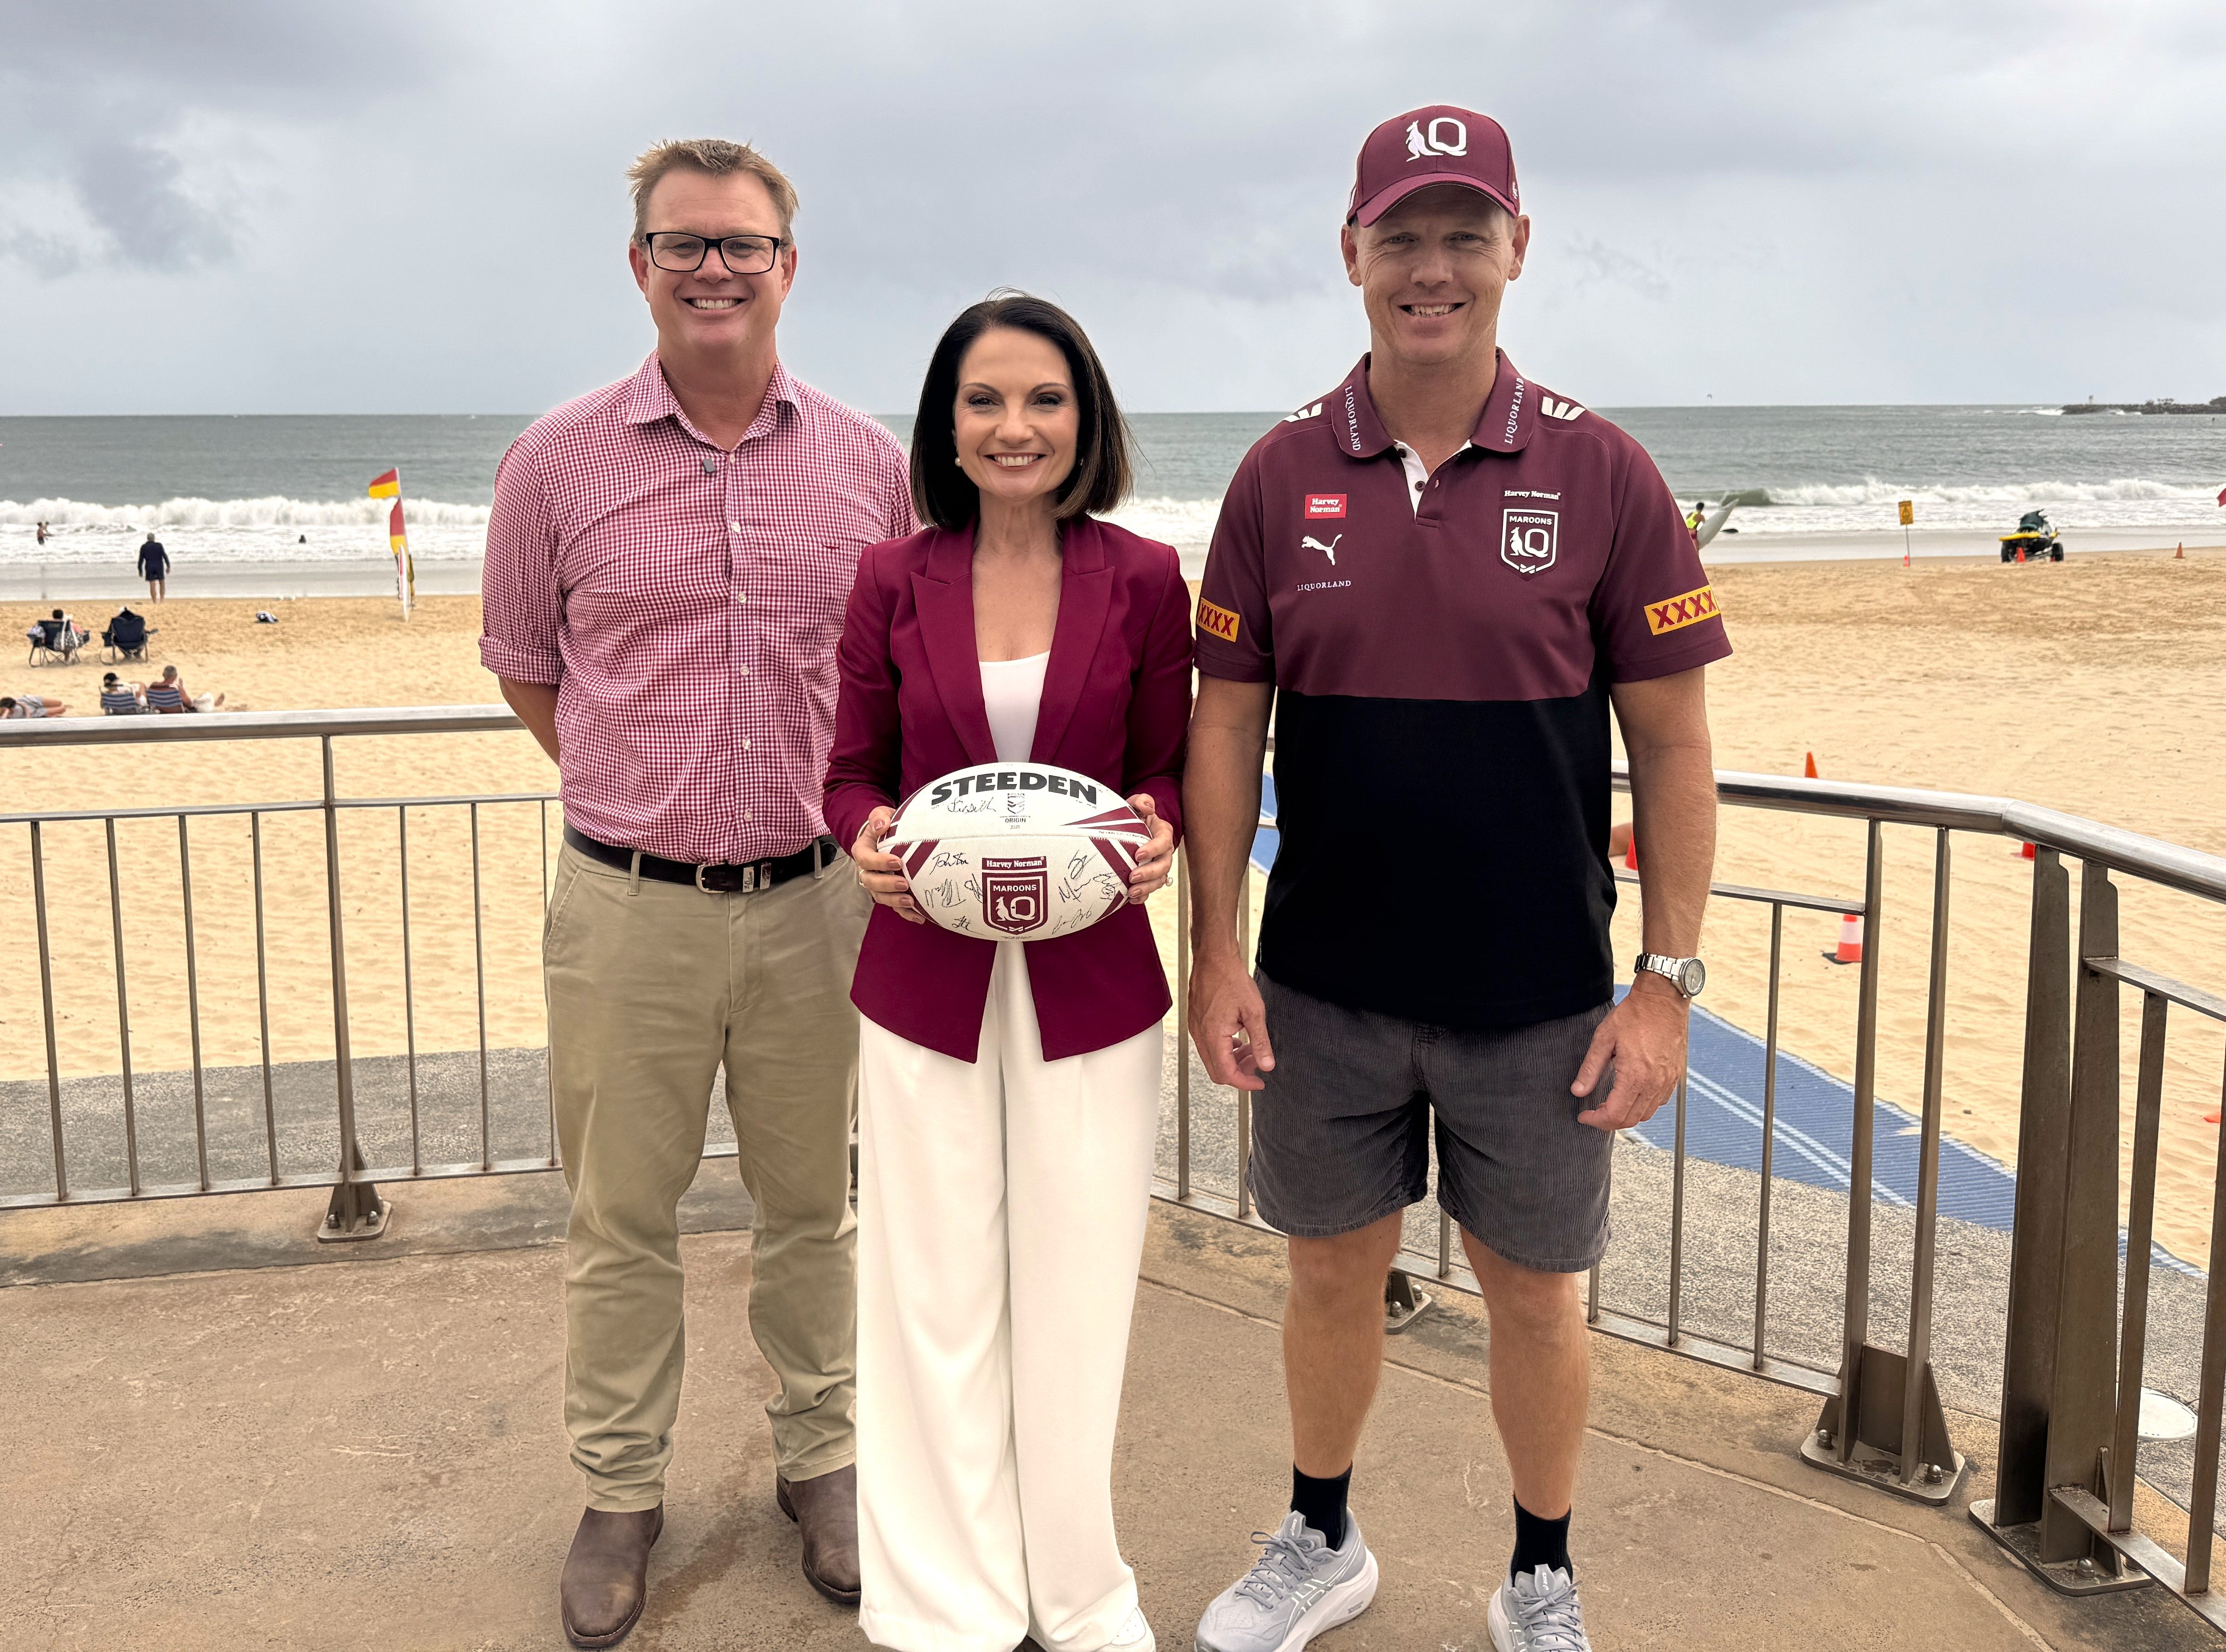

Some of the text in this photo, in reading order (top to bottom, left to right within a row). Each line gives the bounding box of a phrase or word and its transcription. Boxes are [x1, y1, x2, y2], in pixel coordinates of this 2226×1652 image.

[1345, 385, 1361, 451] LIQUORLAND
[1504, 377, 1524, 444] LIQUORLAND
[1531, 490, 1559, 500] Norman
[1509, 516, 1552, 525] MAROONS
[1297, 580, 1351, 591] LIQUORLAND
[1198, 603, 1235, 637] XXXX
[1651, 590, 1717, 629] XXXX
[932, 772, 1097, 806] STEEDEN
[986, 860, 1012, 869] Harvey
